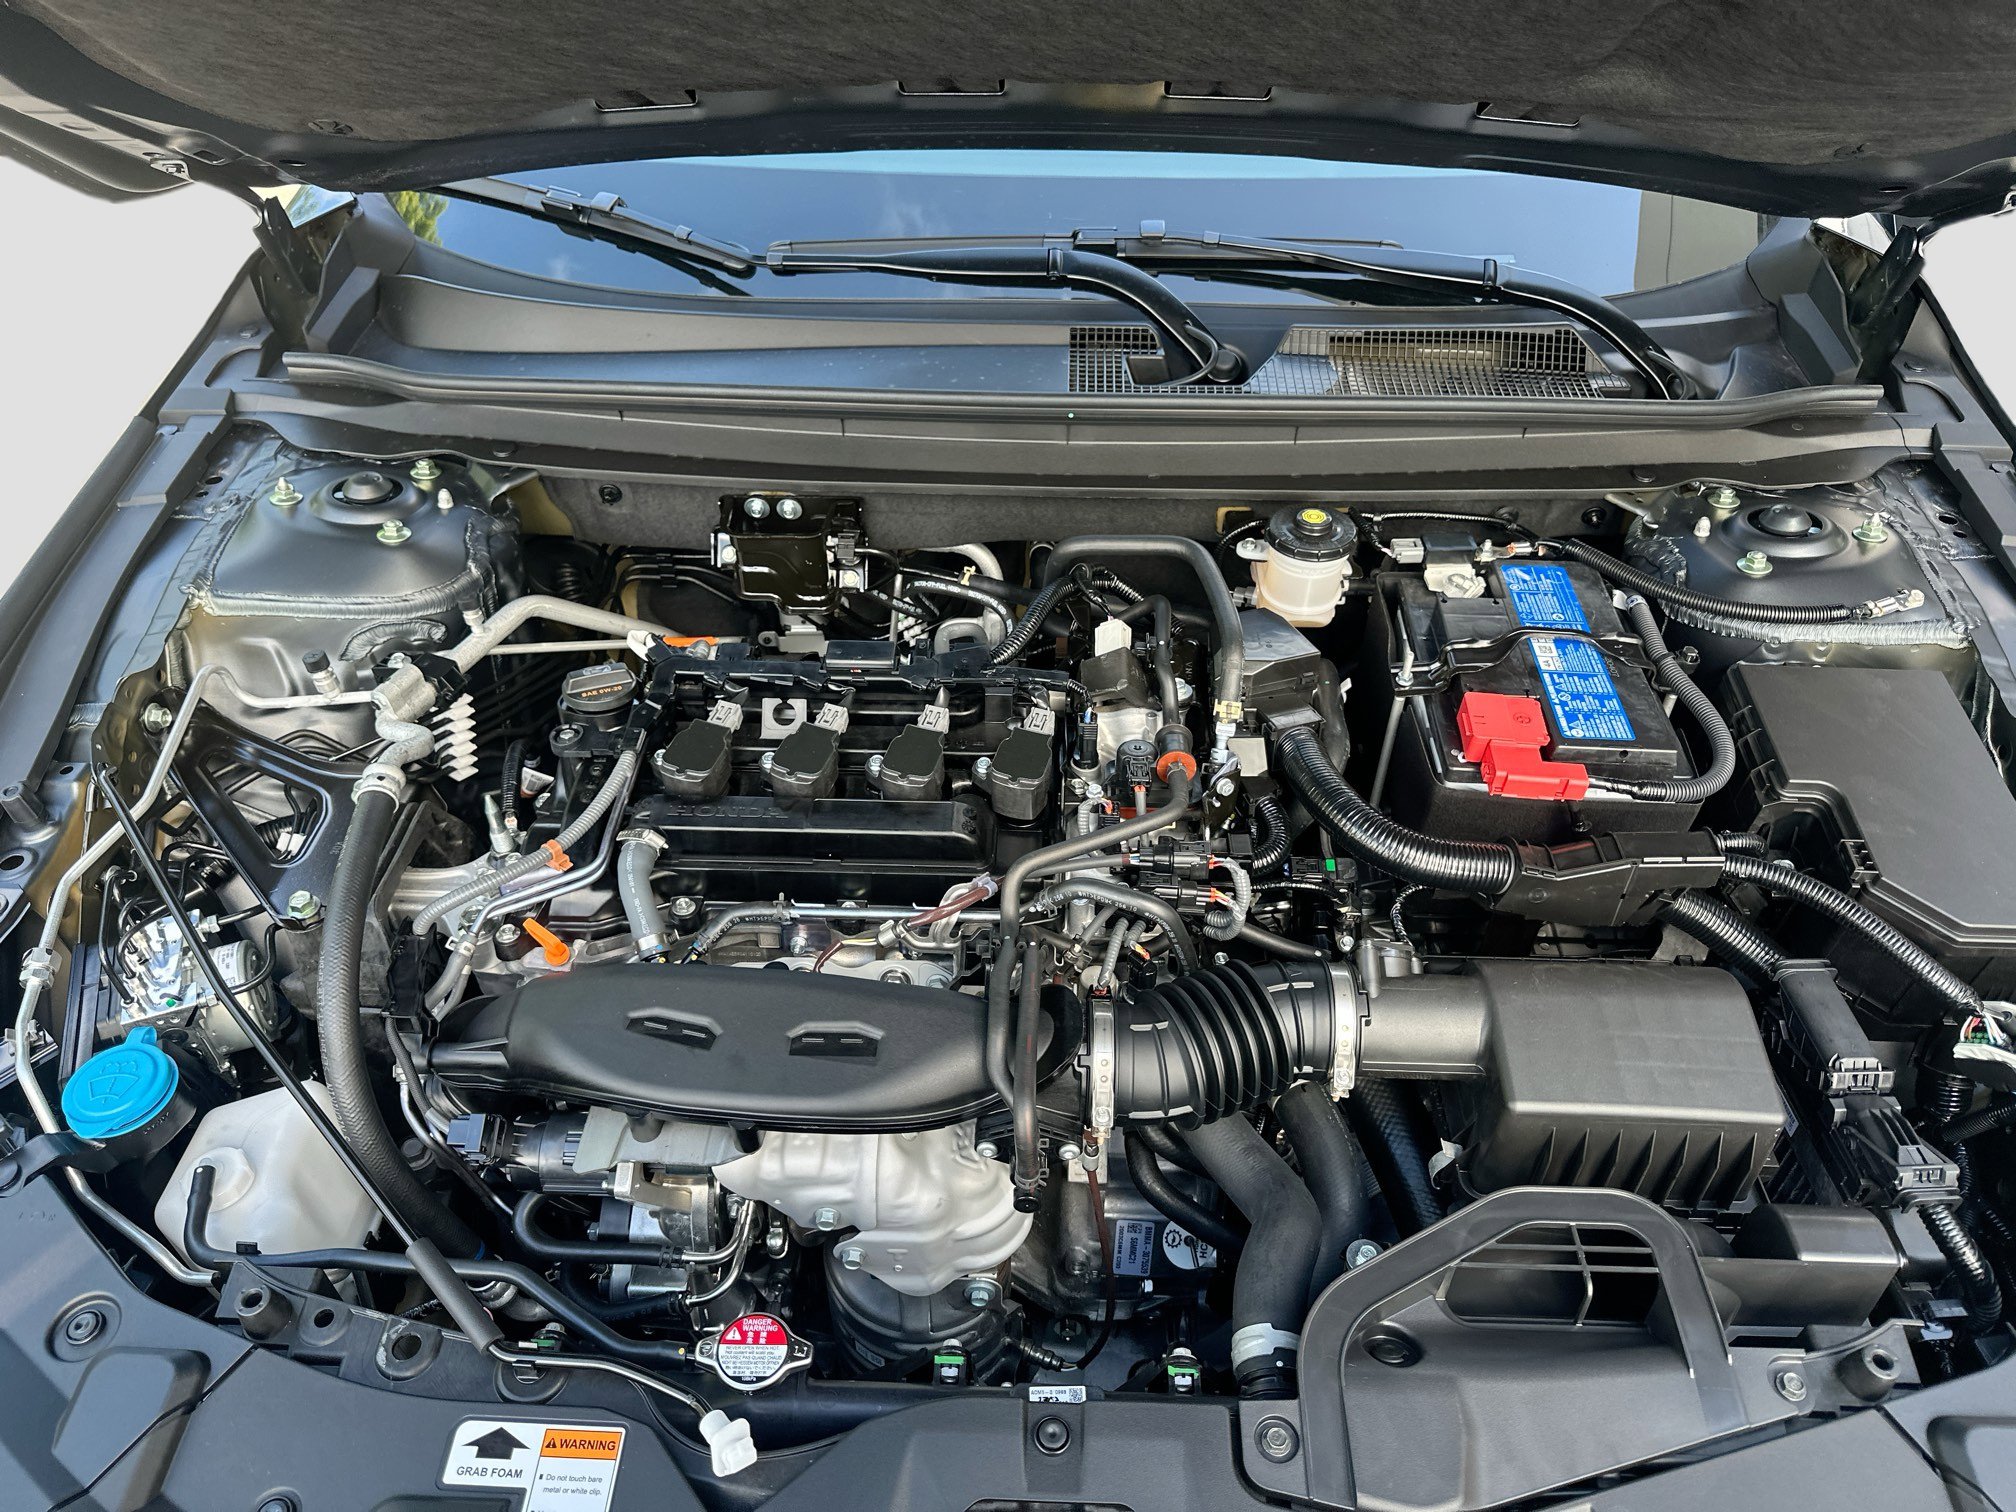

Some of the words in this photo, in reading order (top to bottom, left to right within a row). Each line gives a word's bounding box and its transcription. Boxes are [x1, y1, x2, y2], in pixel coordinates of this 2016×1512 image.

[599, 685, 623, 694] 0W-20
[667, 804, 789, 819] HONDA
[560, 1438, 617, 1451] WARNING
[456, 1466, 488, 1477] GRAB
[490, 1467, 523, 1479] FOAM
[546, 1473, 556, 1481] Do
[543, 1486, 561, 1494] metal
[570, 1487, 588, 1495] white
